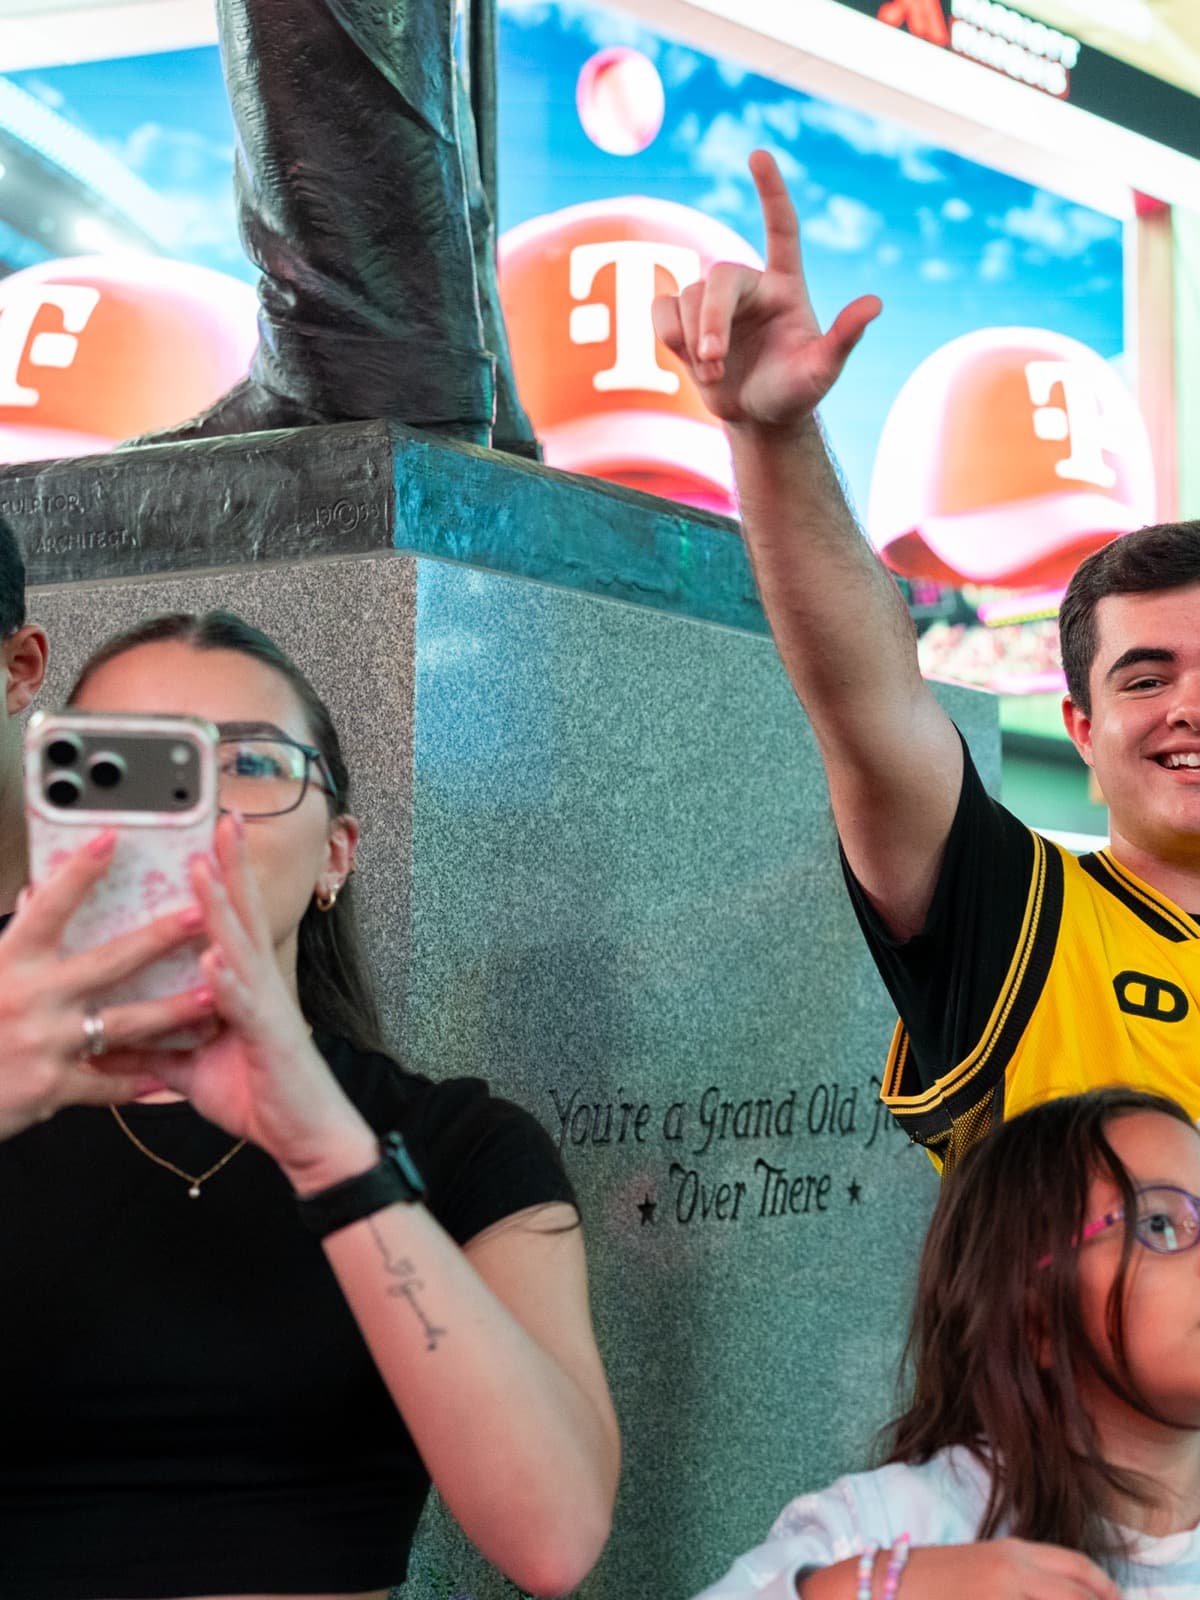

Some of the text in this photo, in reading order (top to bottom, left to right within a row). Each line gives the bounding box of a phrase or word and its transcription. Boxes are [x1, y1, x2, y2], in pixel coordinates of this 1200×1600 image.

[549, 1088, 651, 1147] You're
[661, 1101, 686, 1141] a
[694, 1086, 798, 1154] Grand
[807, 1084, 858, 1135] Old
[669, 1158, 832, 1224] Over There
